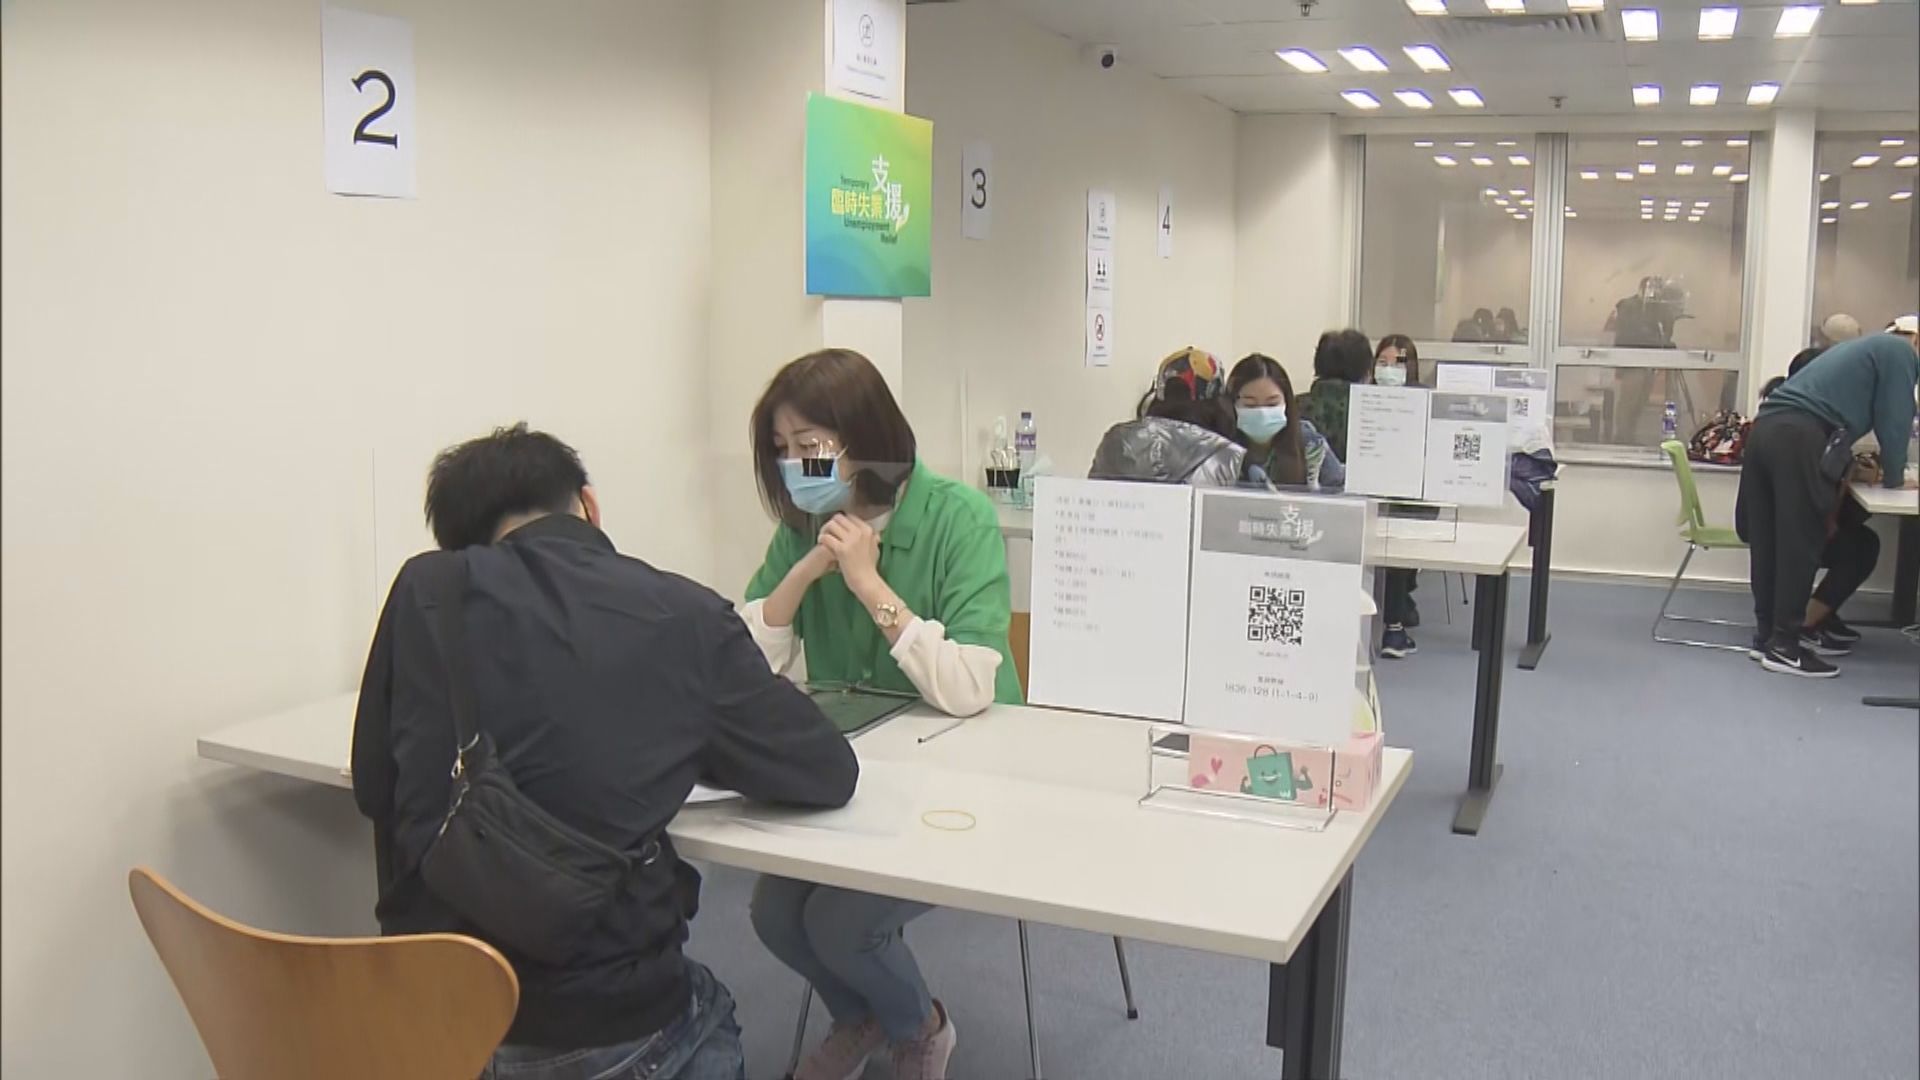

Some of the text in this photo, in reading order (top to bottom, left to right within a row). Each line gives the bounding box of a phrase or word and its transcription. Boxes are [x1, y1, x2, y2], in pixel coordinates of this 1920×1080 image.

[351, 69, 398, 149] 2
[971, 168, 987, 209] 3
[844, 217, 890, 231] Unemployment
[1162, 204, 1171, 235] 4
